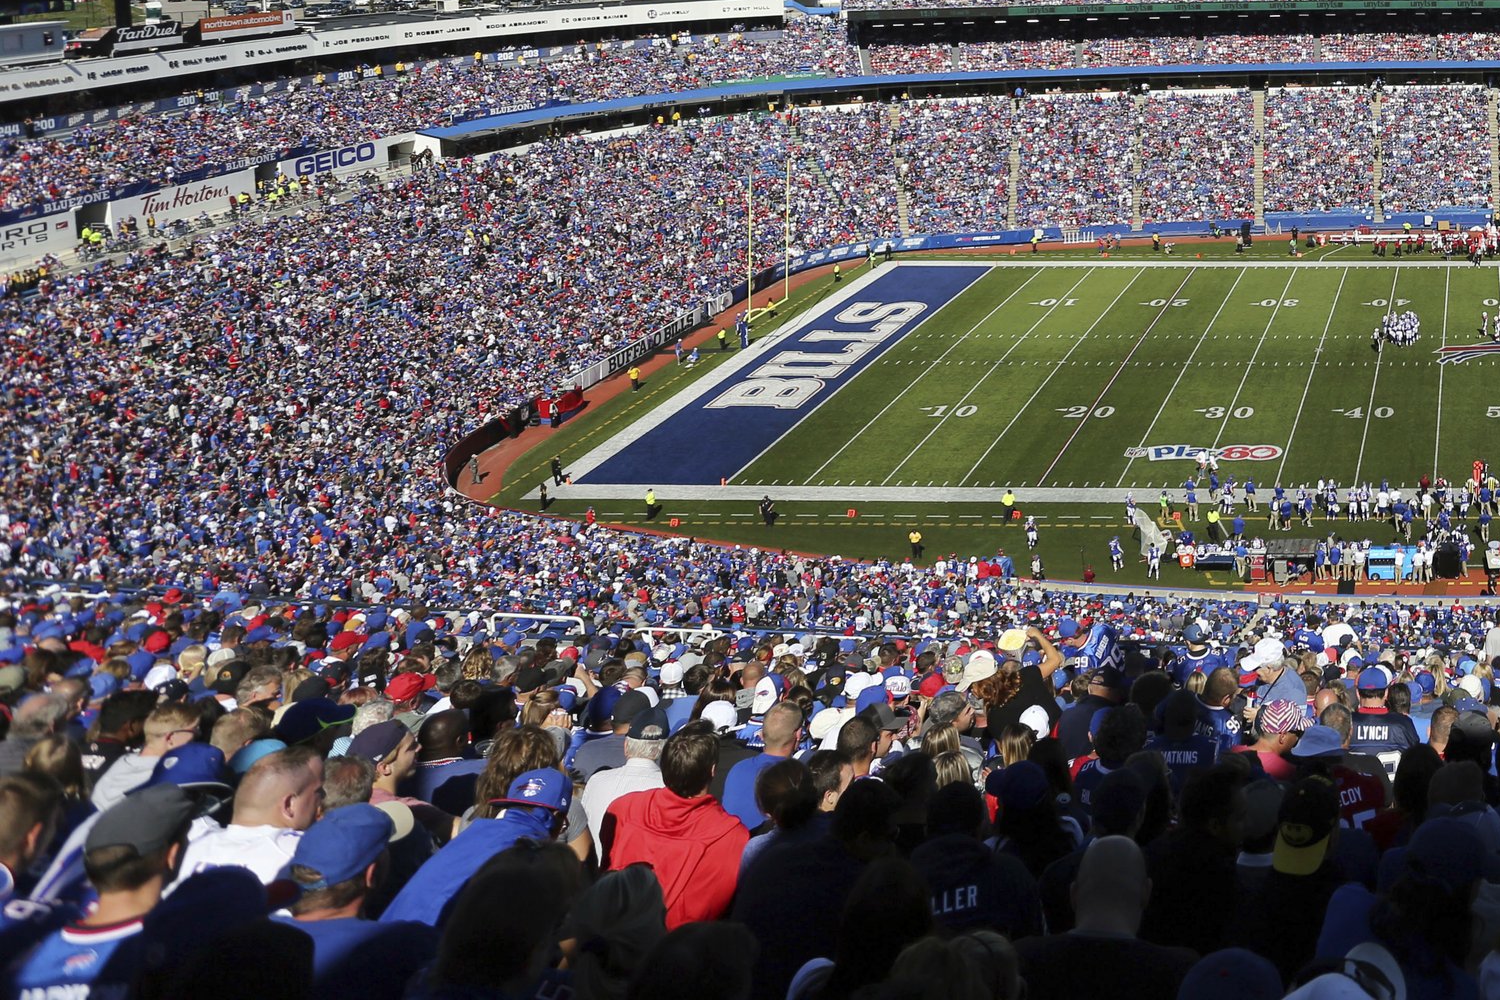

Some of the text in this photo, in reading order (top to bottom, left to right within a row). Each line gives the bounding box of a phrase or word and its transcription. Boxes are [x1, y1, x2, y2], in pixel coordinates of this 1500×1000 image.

[204, 19, 243, 30] northtown
[242, 14, 281, 25] automotive
[116, 23, 178, 42] FanDuel
[416, 28, 444, 36] ROBERT
[351, 35, 390, 43] FERGUSON
[497, 52, 514, 61] 202
[523, 49, 539, 58] 203
[183, 58, 203, 67] BILLY
[100, 68, 124, 78] JACK
[338, 71, 354, 81] 201
[23, 78, 60, 89] WILSON
[177, 96, 196, 106] 200
[204, 91, 220, 102] 201
[295, 142, 376, 177] GEICO
[43, 190, 111, 213] BLUEZONE
[141, 184, 229, 216] Tim Hortons
[664, 313, 694, 342] BILLS
[702, 301, 928, 409] BILLS
[925, 404, 979, 418] 10
[1062, 405, 1116, 419] 20
[1205, 406, 1255, 419] 30
[1344, 405, 1395, 419] 40
[1223, 445, 1279, 459] 60
[1074, 656, 1088, 668] 99
[1357, 725, 1389, 741] LYNCH
